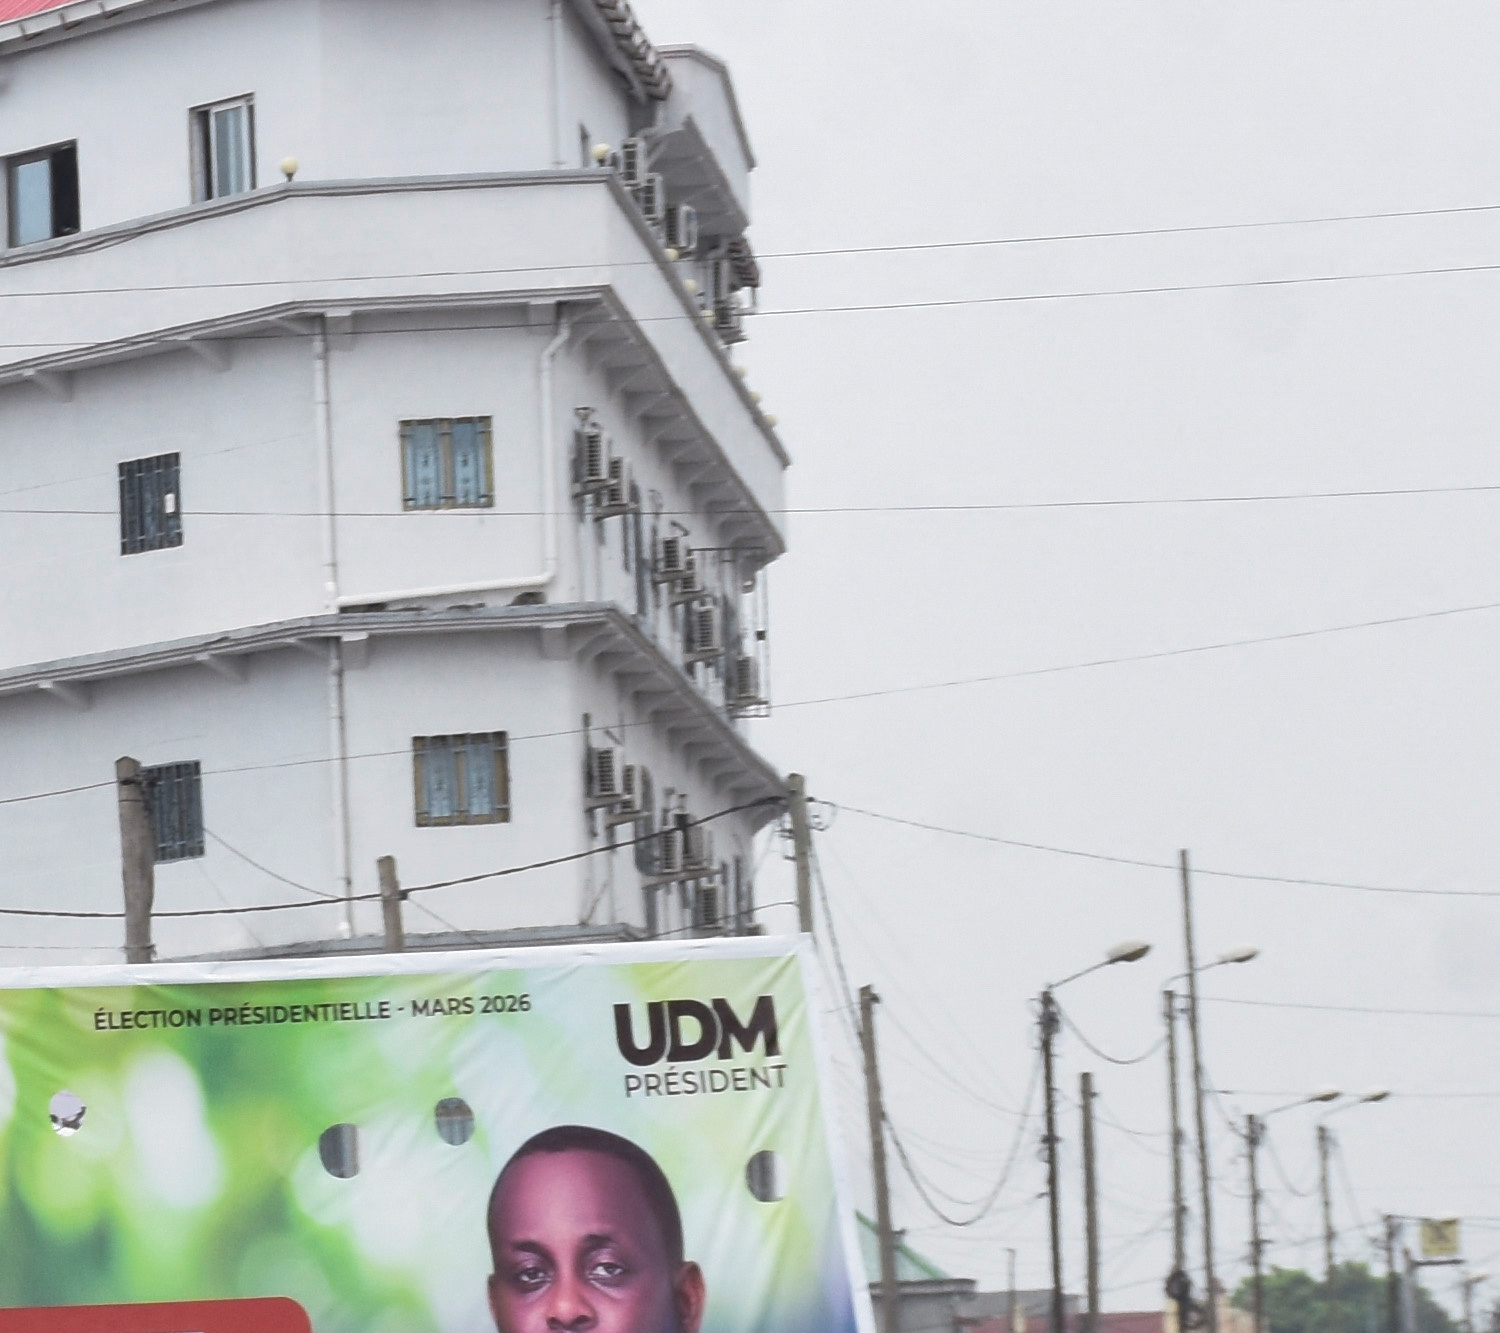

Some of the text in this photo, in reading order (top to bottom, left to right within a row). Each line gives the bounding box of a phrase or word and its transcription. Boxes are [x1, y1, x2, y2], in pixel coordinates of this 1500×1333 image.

[94, 1007, 201, 1030] ÉLECTION
[209, 1001, 392, 1027] PRÉSIDENTIELLE
[411, 997, 475, 1018] MARS
[480, 993, 532, 1013] 2026
[612, 995, 782, 1066] UDM
[624, 1064, 788, 1098] PRÉSIDENT
